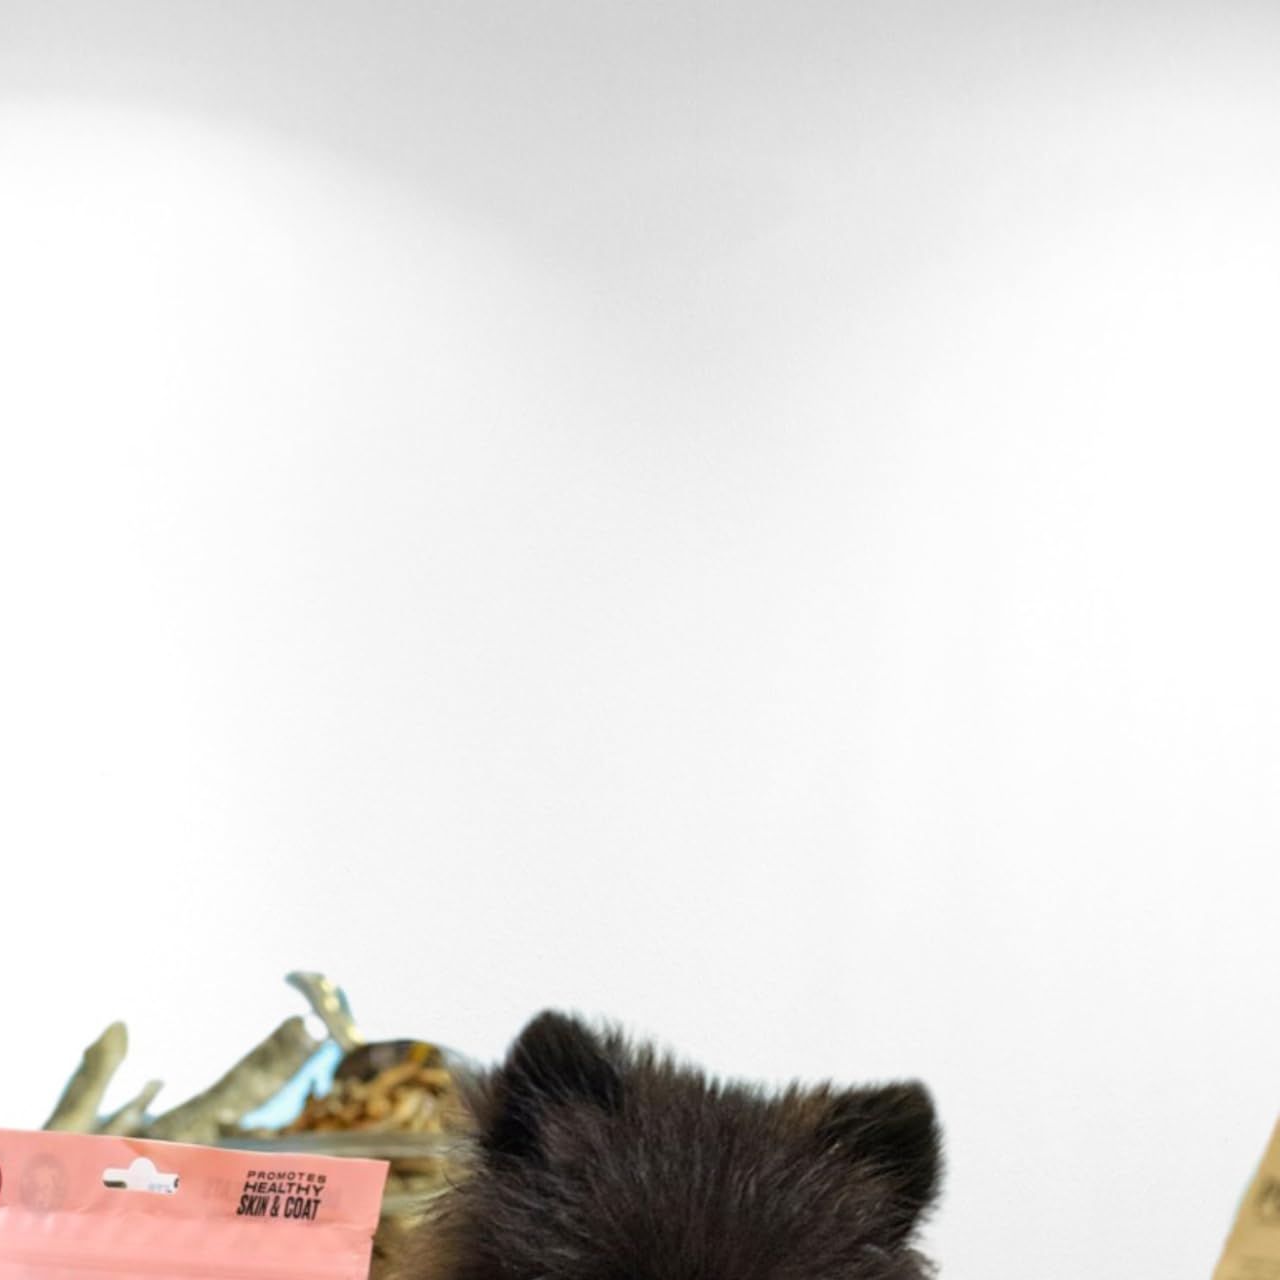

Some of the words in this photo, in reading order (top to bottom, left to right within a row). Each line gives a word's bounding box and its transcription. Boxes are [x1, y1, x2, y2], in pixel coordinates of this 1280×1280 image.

[247, 1170, 327, 1183] PROMOTES
[243, 1181, 324, 1196] HEALTHY
[236, 1194, 269, 1217] SKIN
[270, 1195, 280, 1217] &
[284, 1196, 322, 1221] COAT
